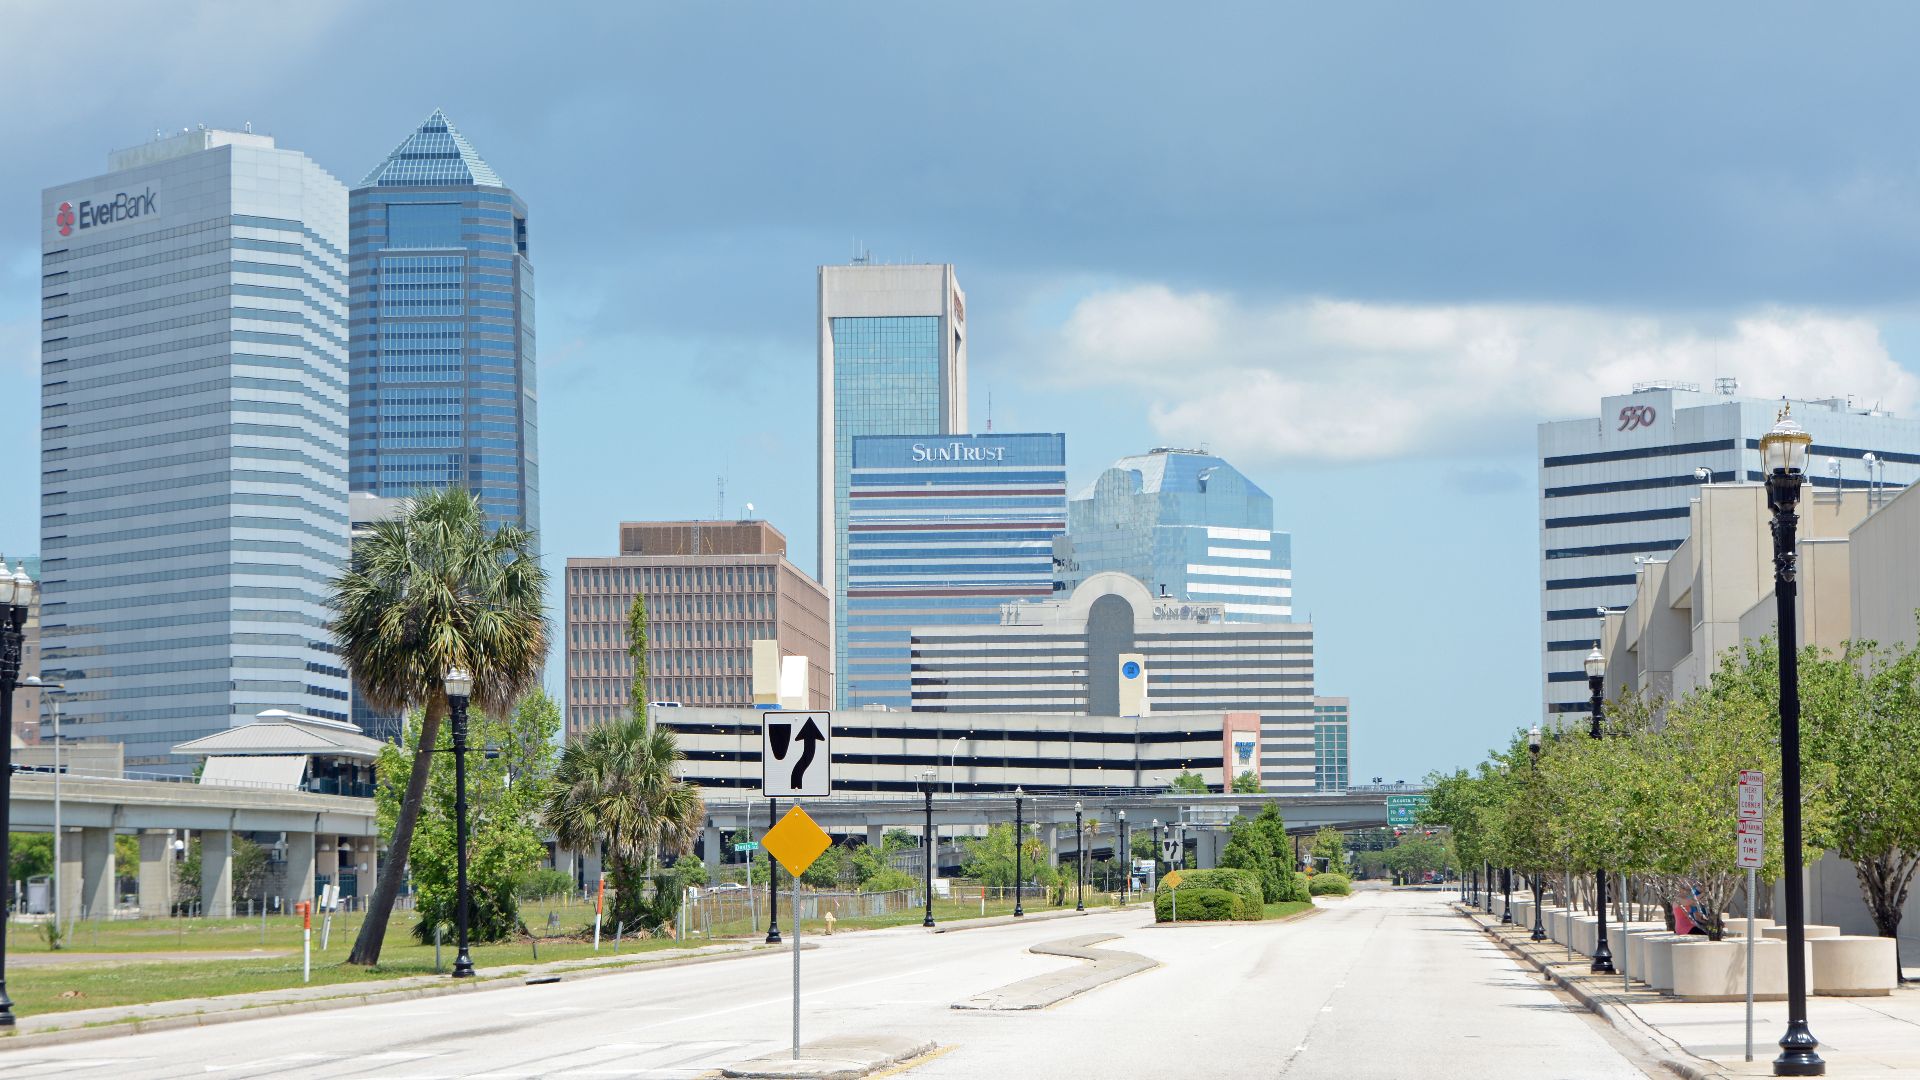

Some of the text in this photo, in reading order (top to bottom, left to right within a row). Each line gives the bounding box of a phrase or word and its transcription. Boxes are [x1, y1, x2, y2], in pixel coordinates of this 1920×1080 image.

[79, 186, 156, 229] EverBank
[1617, 405, 1656, 431] 550
[1744, 786, 1757, 794] HERE
[1741, 801, 1761, 809] CORNER
[1743, 837, 1757, 845] ANY
[1743, 846, 1757, 854] TIME
